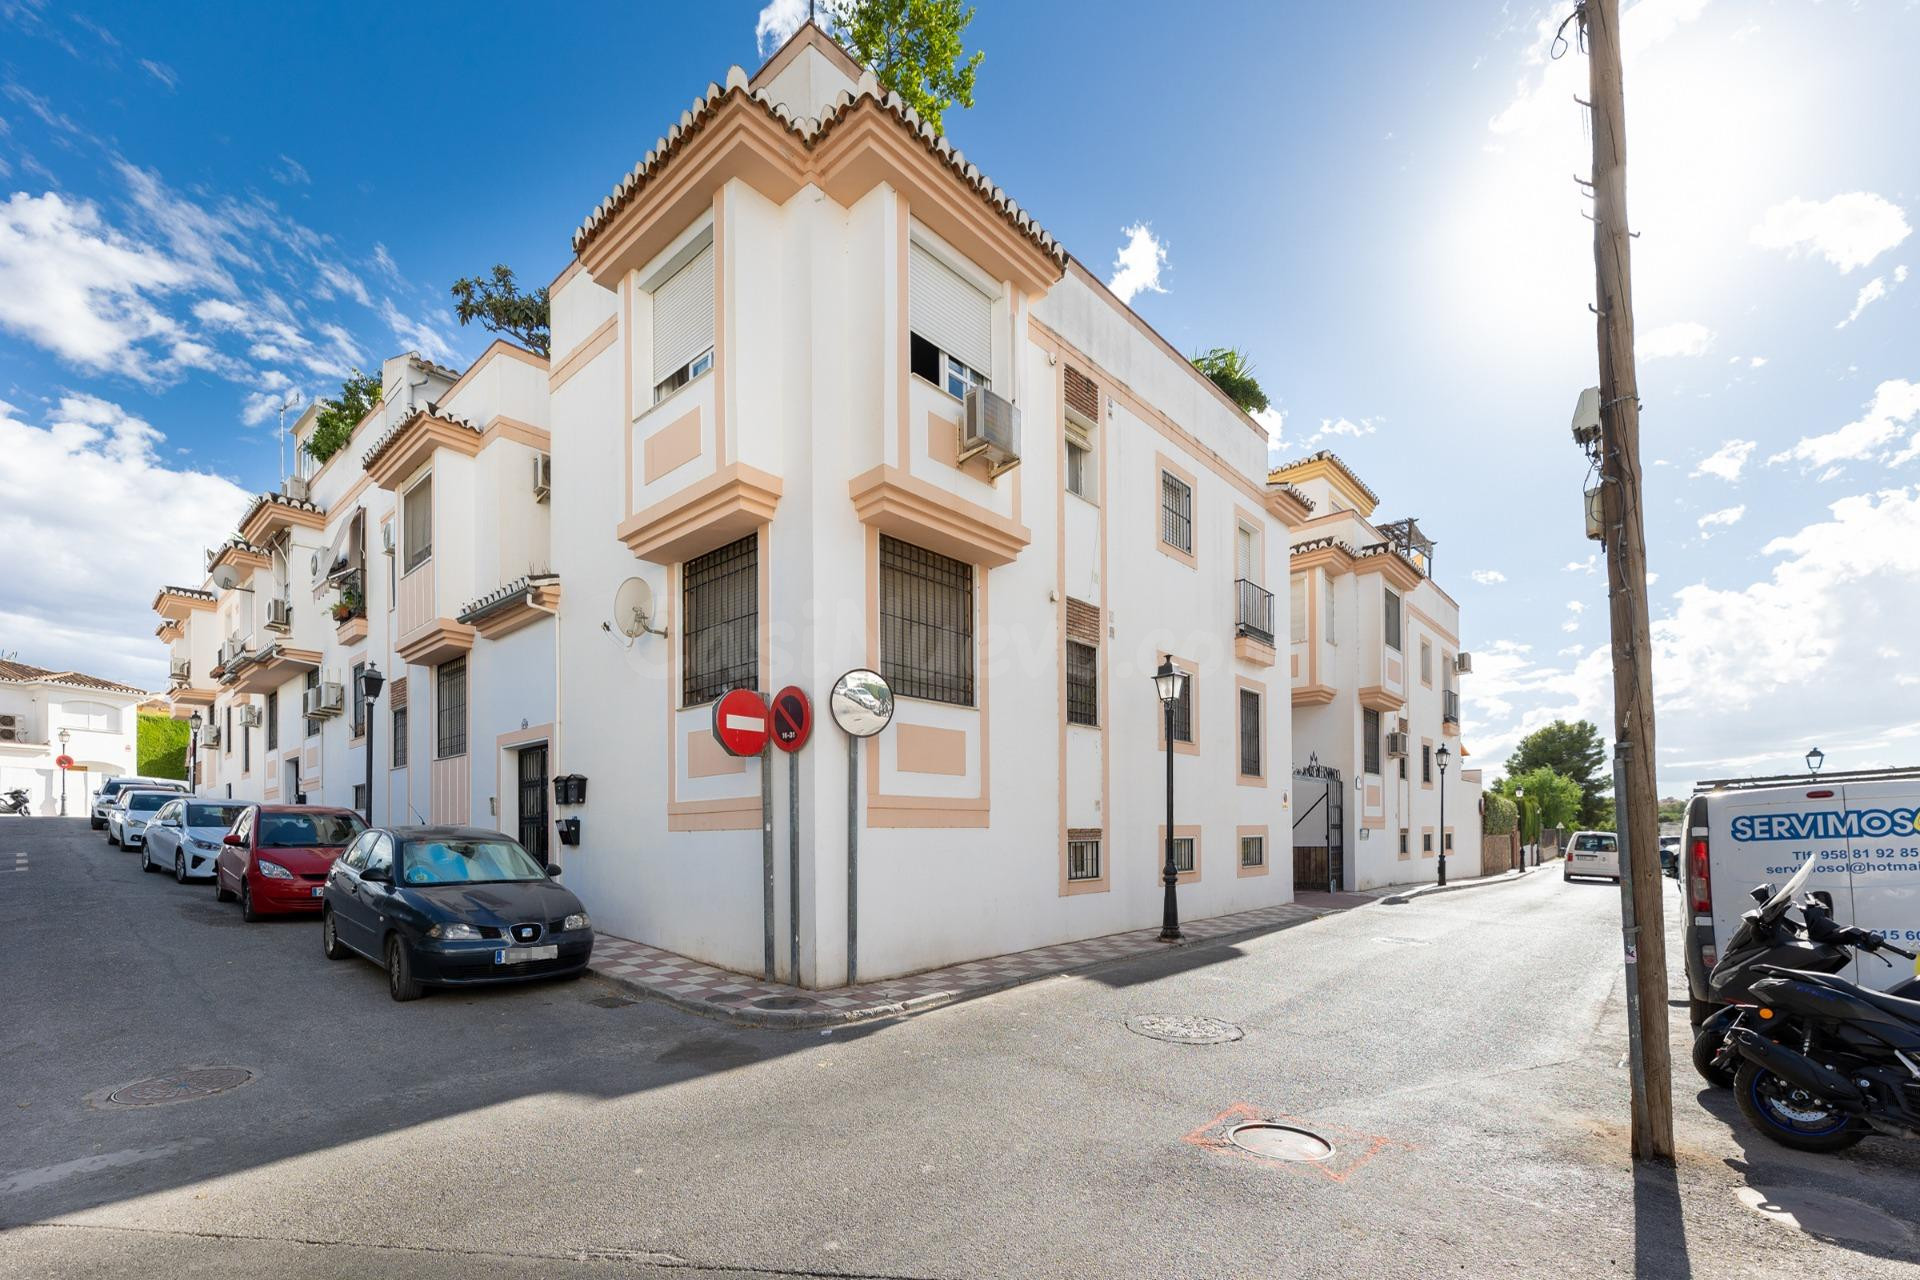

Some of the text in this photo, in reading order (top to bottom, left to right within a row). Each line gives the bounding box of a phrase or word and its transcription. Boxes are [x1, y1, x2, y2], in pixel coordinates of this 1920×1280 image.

[1731, 807, 1920, 842] SERVIMOS
[1820, 850, 1848, 860] 958
[1852, 849, 1870, 858] 81
[1876, 848, 1894, 858] 92
[1900, 847, 1919, 858] 85
[1766, 861, 1920, 874] serviosol@hotmai
